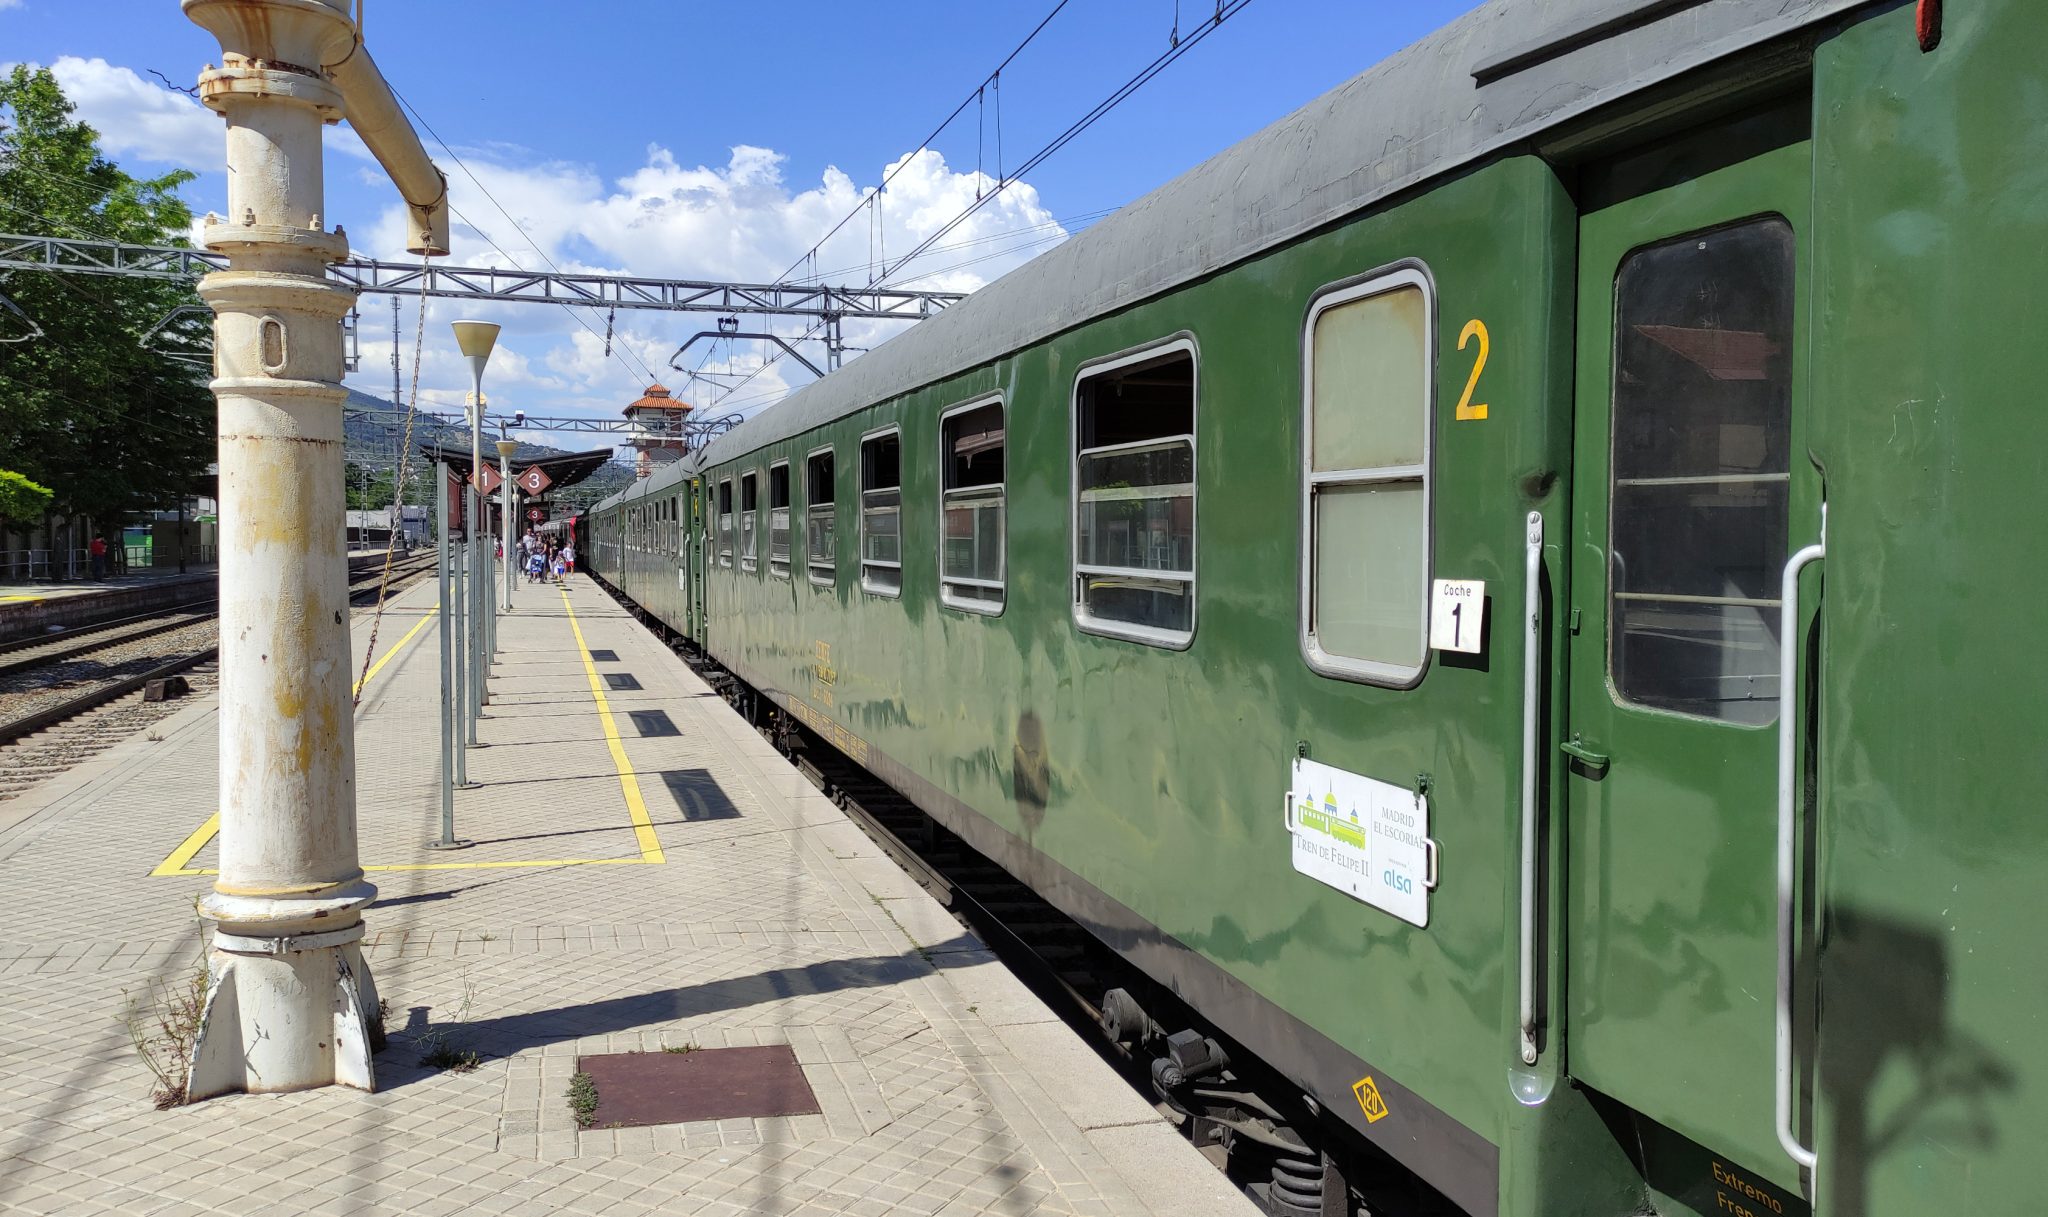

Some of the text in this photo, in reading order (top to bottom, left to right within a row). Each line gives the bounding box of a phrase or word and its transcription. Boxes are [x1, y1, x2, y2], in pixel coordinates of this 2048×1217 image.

[1456, 318, 1490, 421] 2
[481, 471, 488, 487] 1
[528, 473, 540, 488] 3
[531, 510, 538, 519] 3
[1444, 583, 1472, 597] Coche
[1452, 602, 1462, 648] 1
[1381, 806, 1415, 828] MADRID
[1373, 821, 1425, 850] EL ESCORIAL
[1296, 833, 1318, 855] TREN
[1319, 845, 1330, 860] DE
[1331, 847, 1360, 873] FELIPE
[1361, 859, 1369, 877] II
[1383, 869, 1412, 895] alsa
[1362, 1084, 1378, 1114] 120
[1712, 1161, 1782, 1214] Extremo
[1716, 1190, 1757, 1217] Fren
